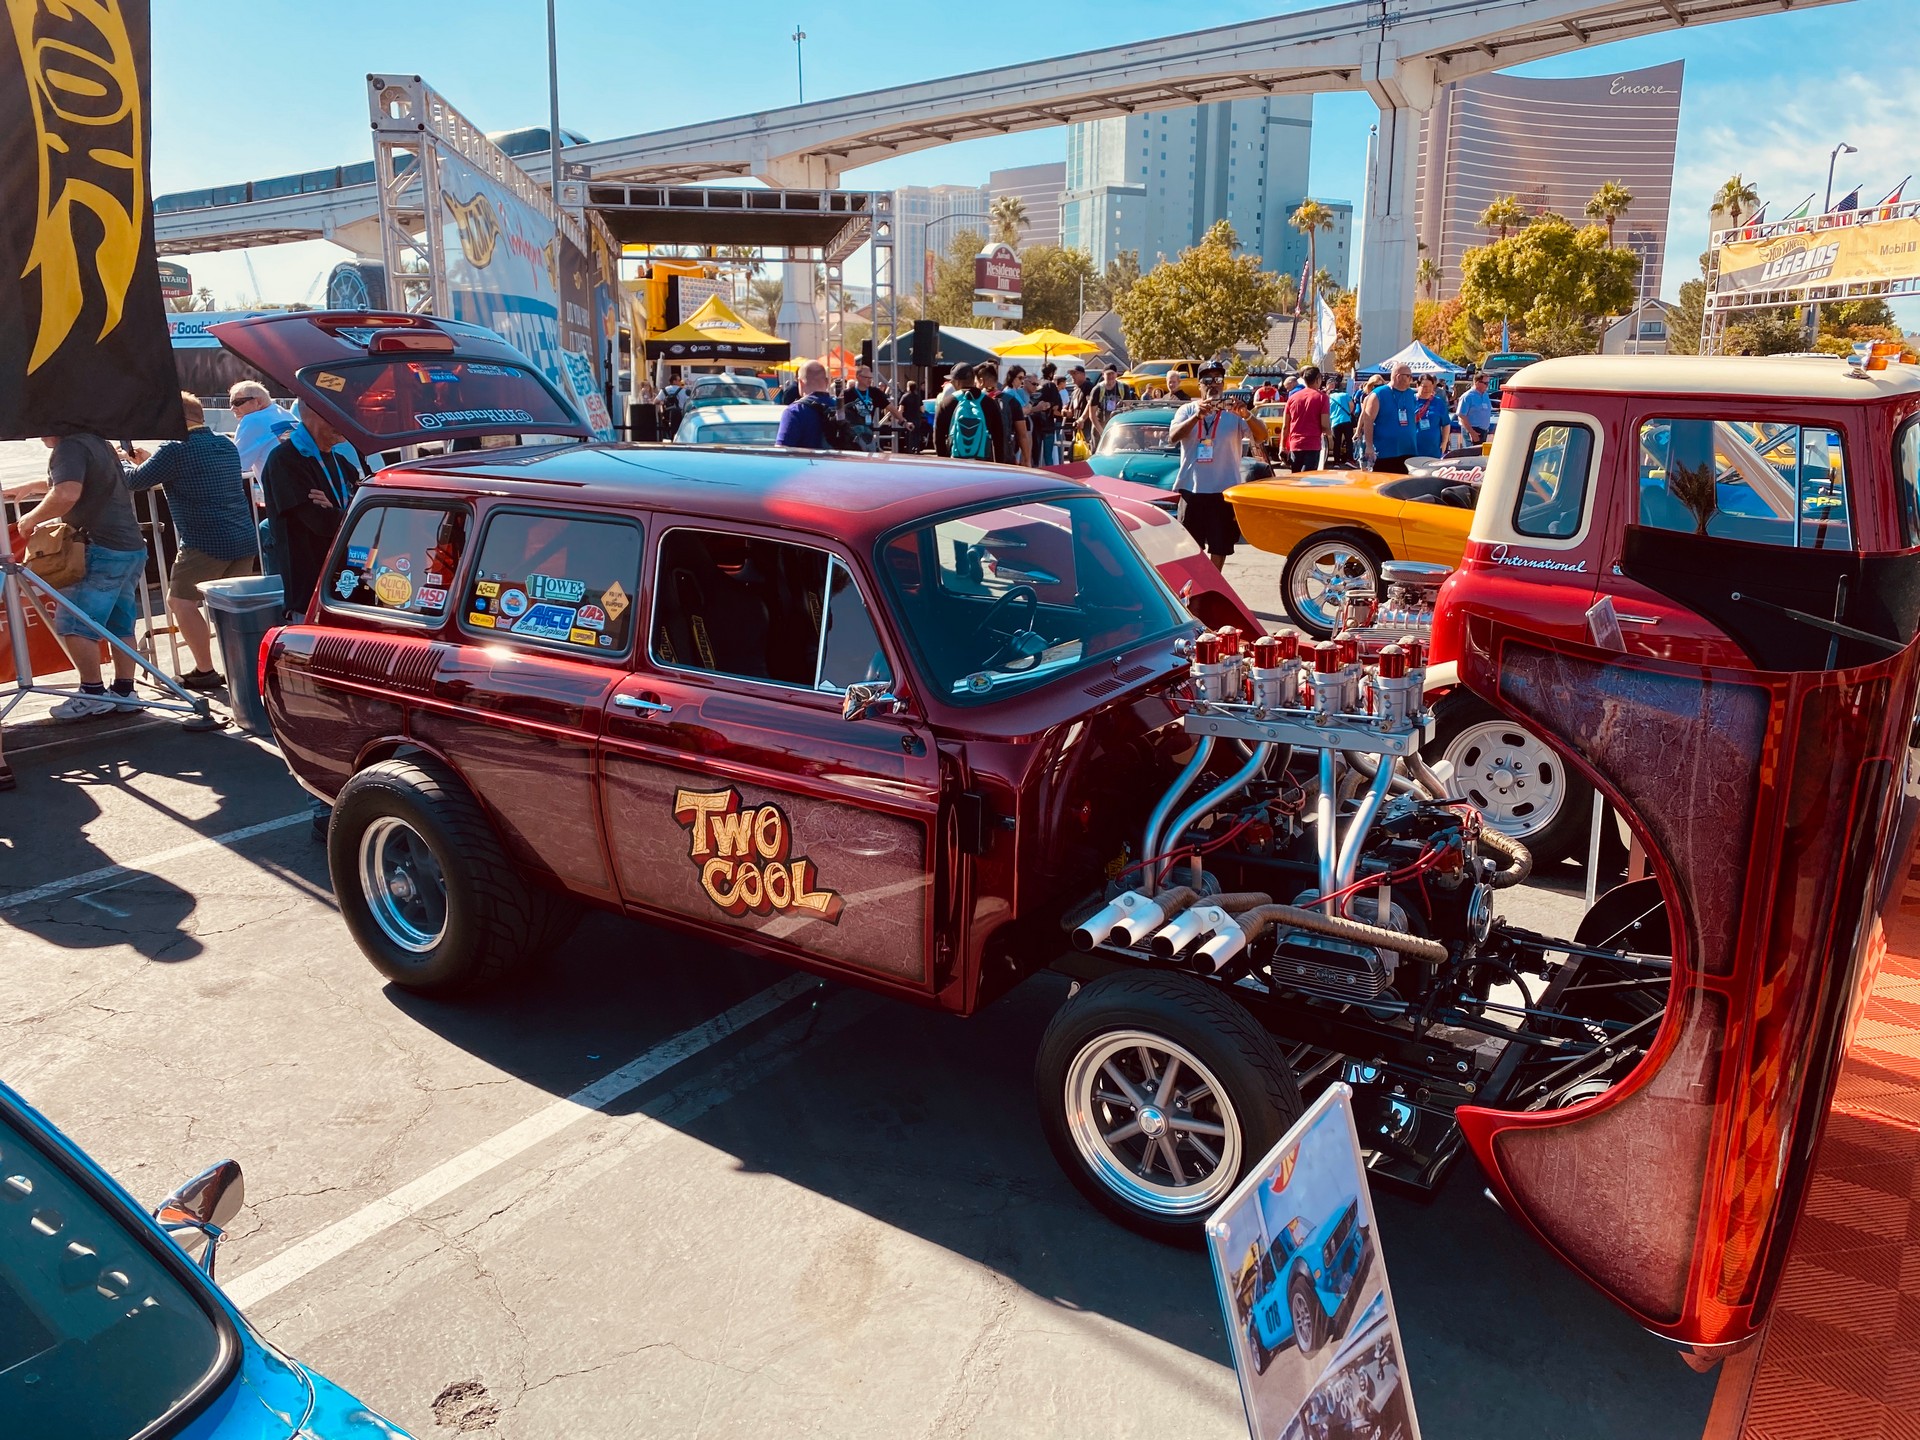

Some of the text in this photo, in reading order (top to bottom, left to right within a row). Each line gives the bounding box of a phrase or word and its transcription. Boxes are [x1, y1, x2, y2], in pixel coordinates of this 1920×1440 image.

[1609, 75, 1678, 95] Encore
[1880, 242, 1906, 256] Mobil
[1760, 242, 1840, 282] LEGENDS
[986, 262, 1020, 278] Residence
[997, 275, 1010, 289] Inn
[737, 345, 758, 353] Walmart
[1490, 544, 1588, 573] International
[380, 576, 407, 590] QUICK
[532, 575, 578, 599] HOWE
[386, 588, 407, 600] TIME
[417, 588, 445, 603] MSD
[578, 606, 604, 621] JAZ
[702, 857, 833, 913] COOL
[1265, 1300, 1281, 1335] 078
